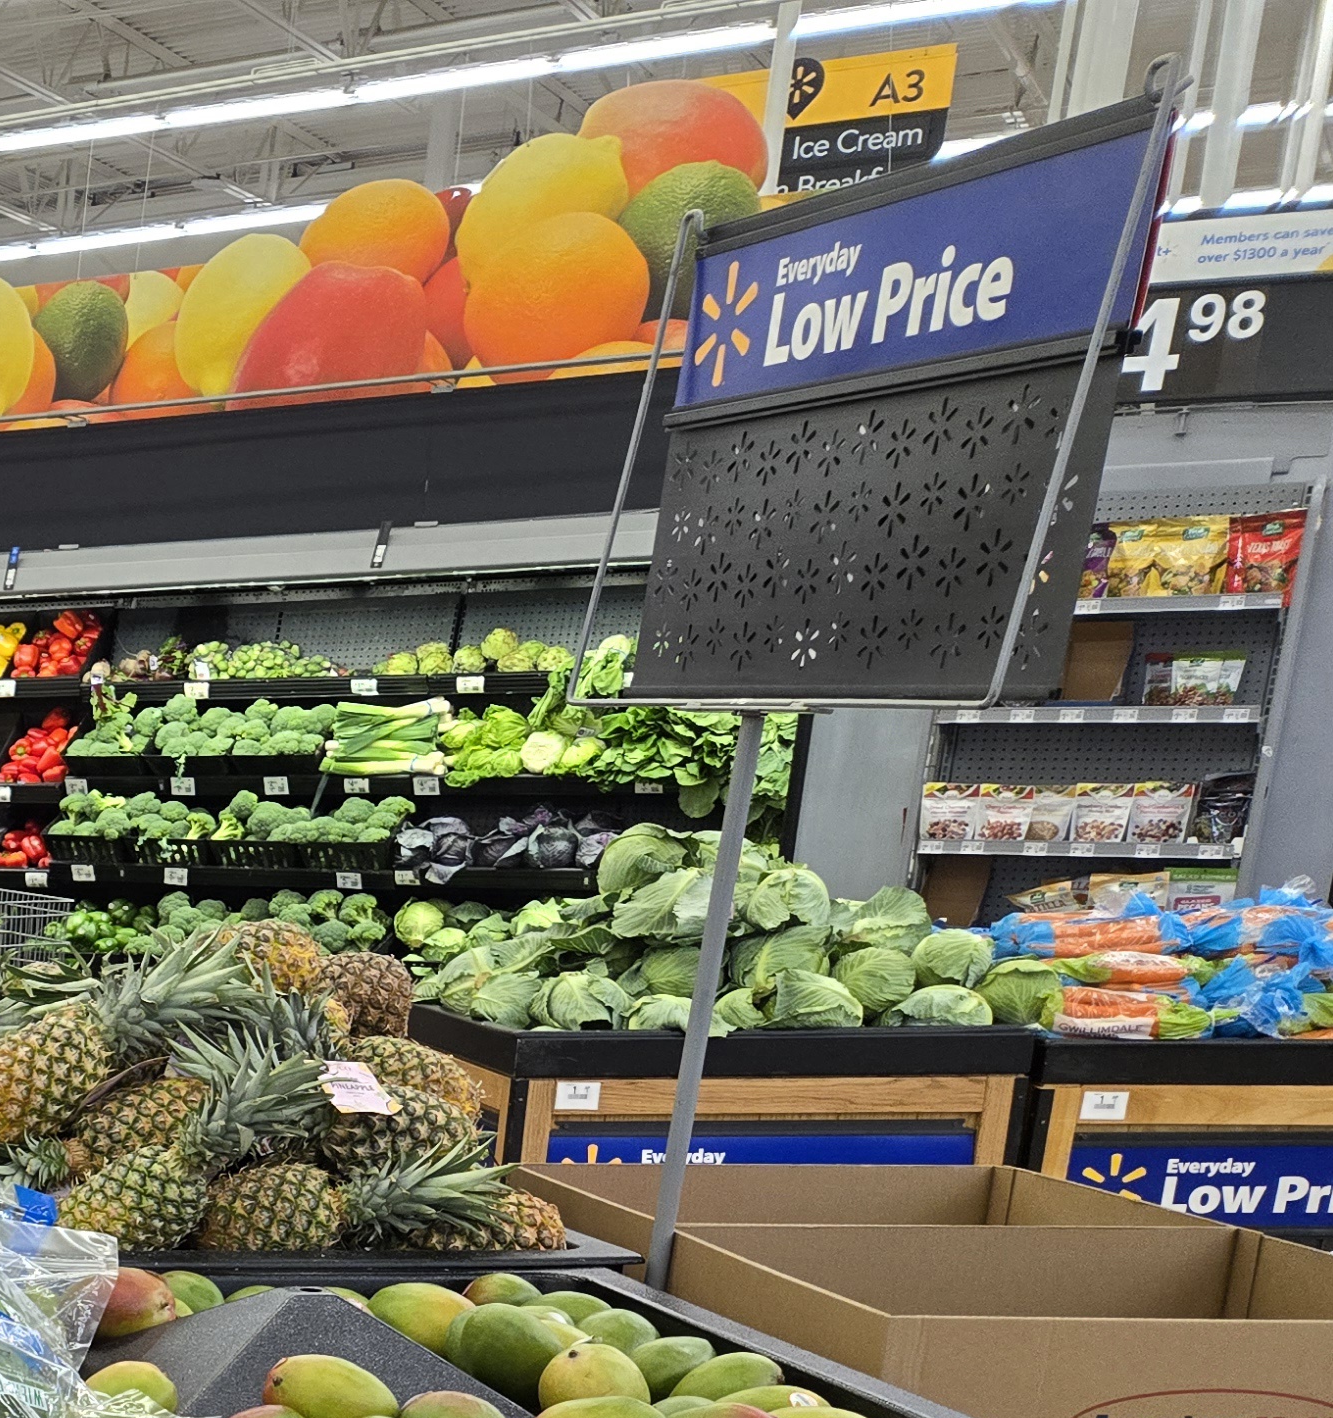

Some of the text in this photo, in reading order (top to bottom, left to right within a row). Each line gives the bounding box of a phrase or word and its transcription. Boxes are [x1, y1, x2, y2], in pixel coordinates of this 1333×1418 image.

[869, 69, 925, 107] A3
[792, 128, 923, 160] Ice Cream
[1200, 225, 1333, 247] Members can save
[776, 241, 863, 287] Everyday
[1197, 245, 1327, 264] over $1300 a year
[763, 244, 1014, 367] Low Price
[331, 1081, 375, 1092] PINEAPPLE
[1166, 1157, 1256, 1178] Everyday
[1161, 1175, 1267, 1215] Low
